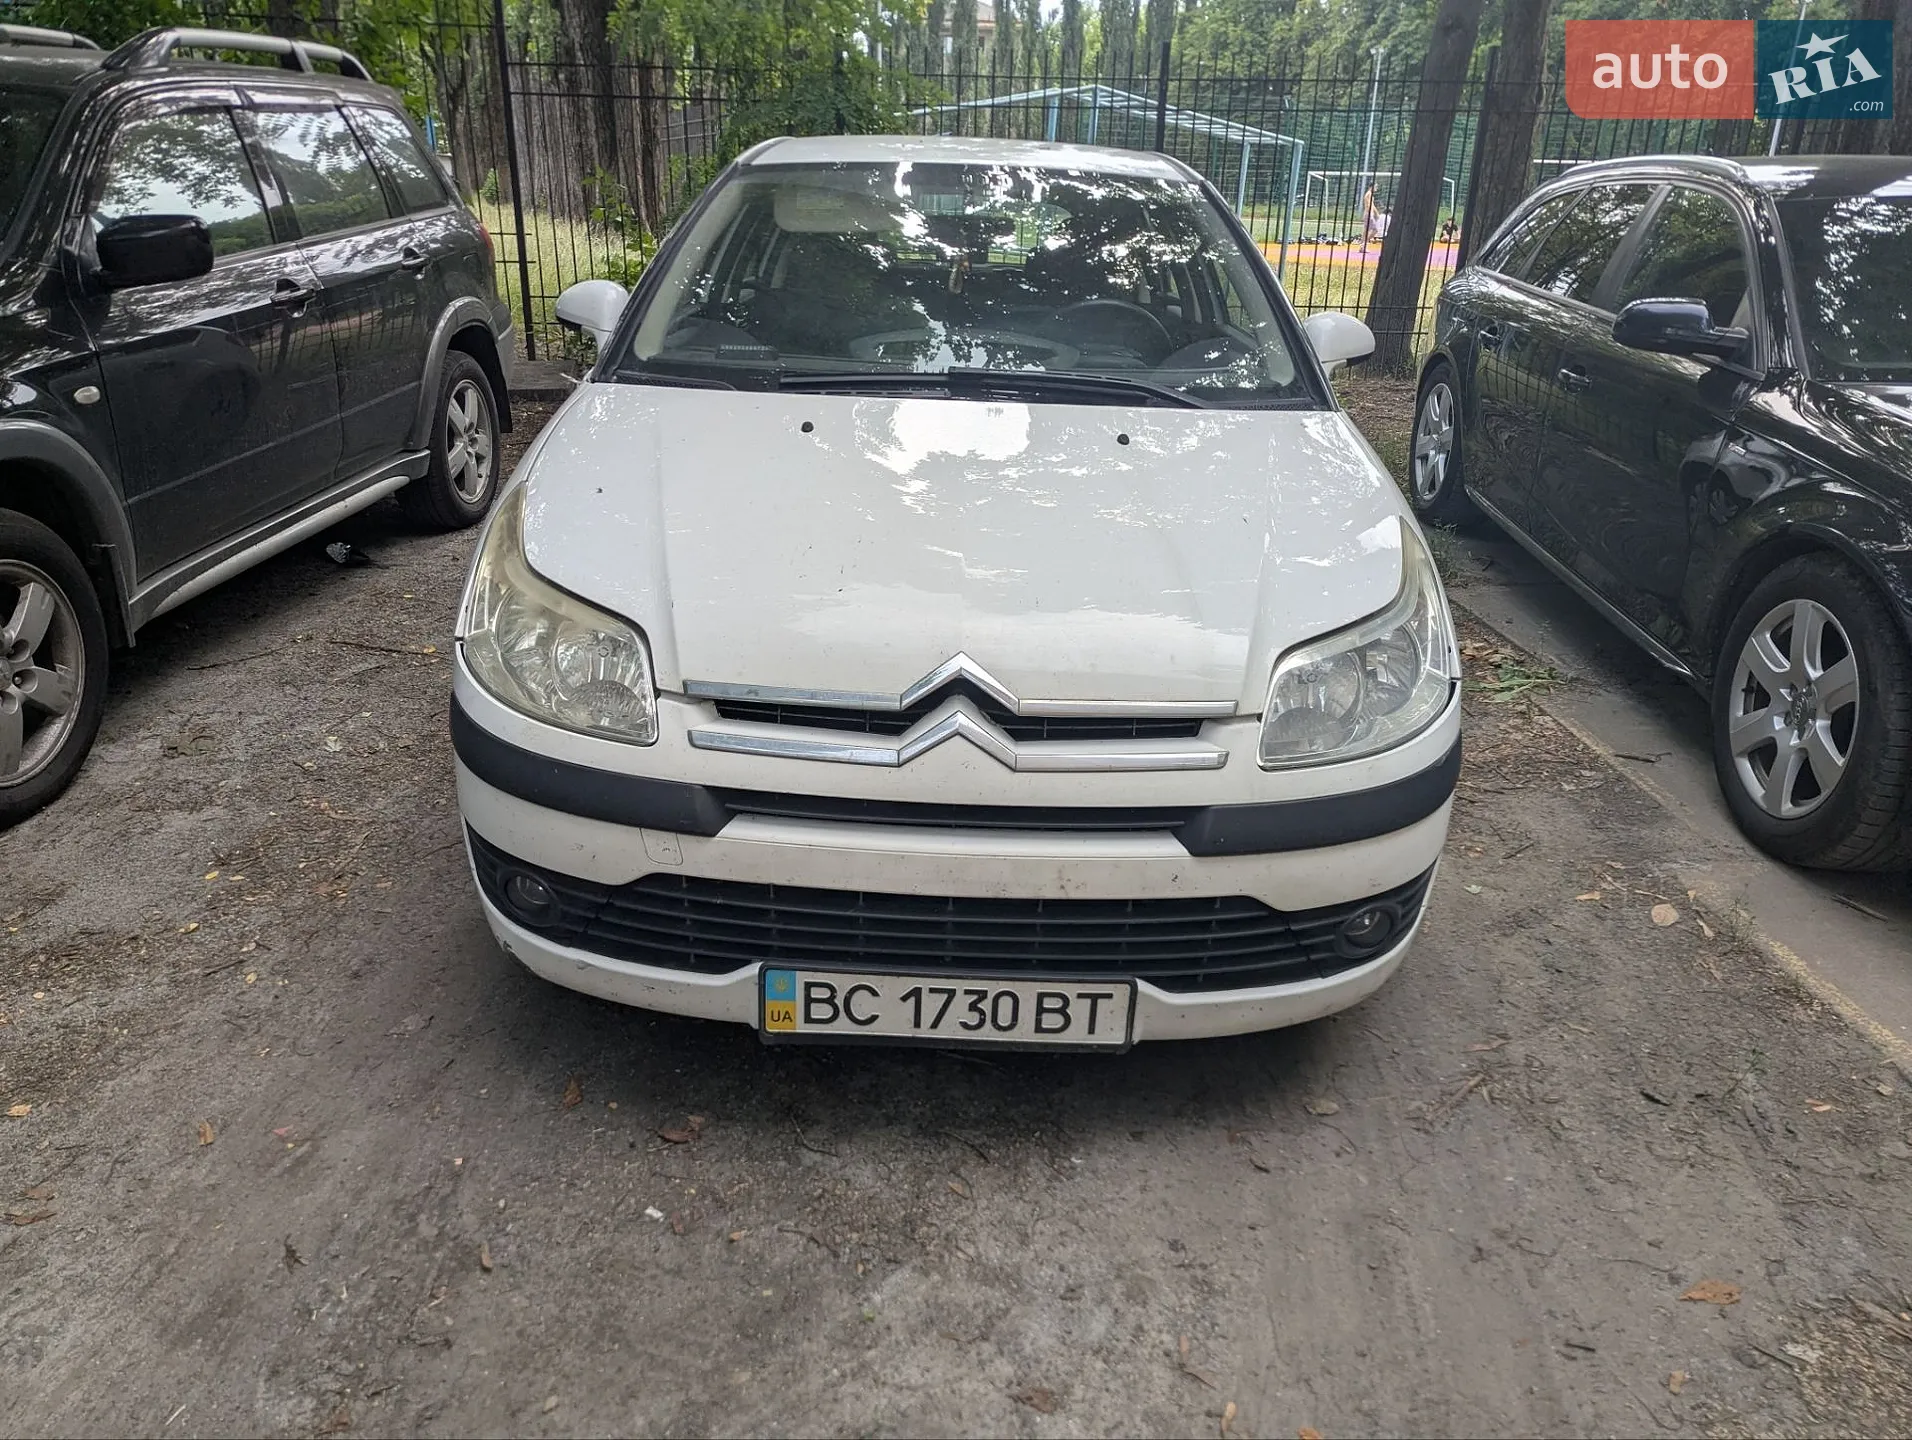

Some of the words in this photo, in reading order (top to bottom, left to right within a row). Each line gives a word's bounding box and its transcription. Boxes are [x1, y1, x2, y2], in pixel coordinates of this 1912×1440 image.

[771, 1009, 793, 1023] UA
[803, 980, 881, 1026] BC
[900, 986, 1020, 1032] 1730
[1033, 991, 1114, 1035] BT
